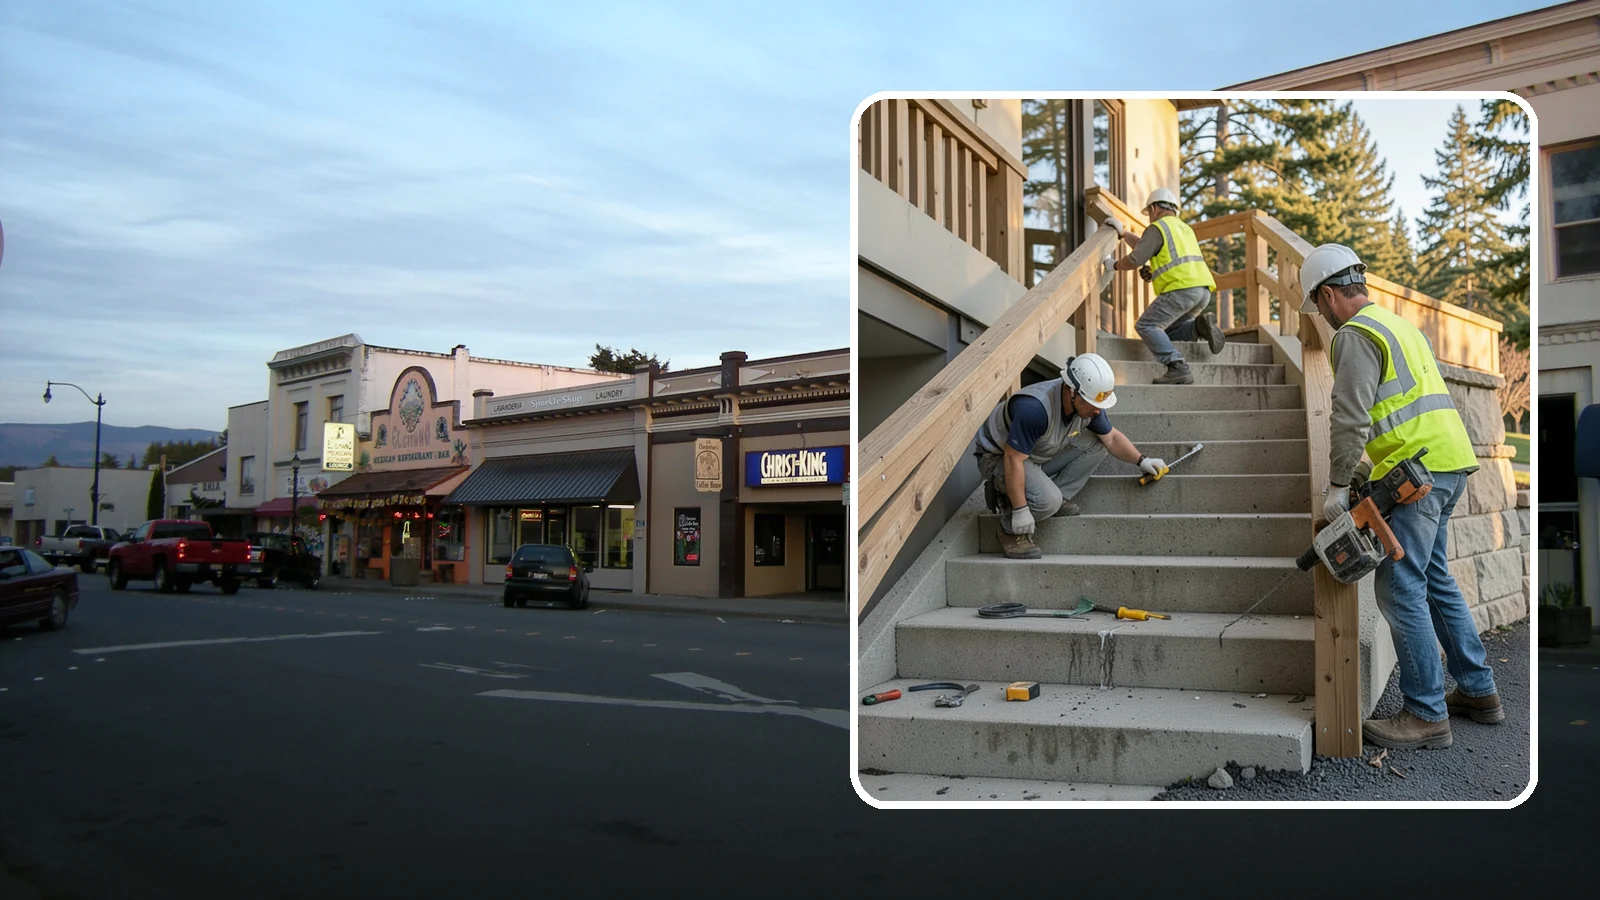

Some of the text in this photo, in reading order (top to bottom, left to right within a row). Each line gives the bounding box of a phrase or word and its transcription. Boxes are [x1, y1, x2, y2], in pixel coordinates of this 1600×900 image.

[595, 388, 624, 400] LAUNDRY
[493, 402, 523, 413] LAVANDERIA
[529, 394, 583, 410] Sparkle Shop
[373, 454, 396, 464] MEXICAN
[397, 451, 434, 463] RESTAURANT
[437, 449, 450, 459] BAR
[696, 481, 722, 489] Coffee House
